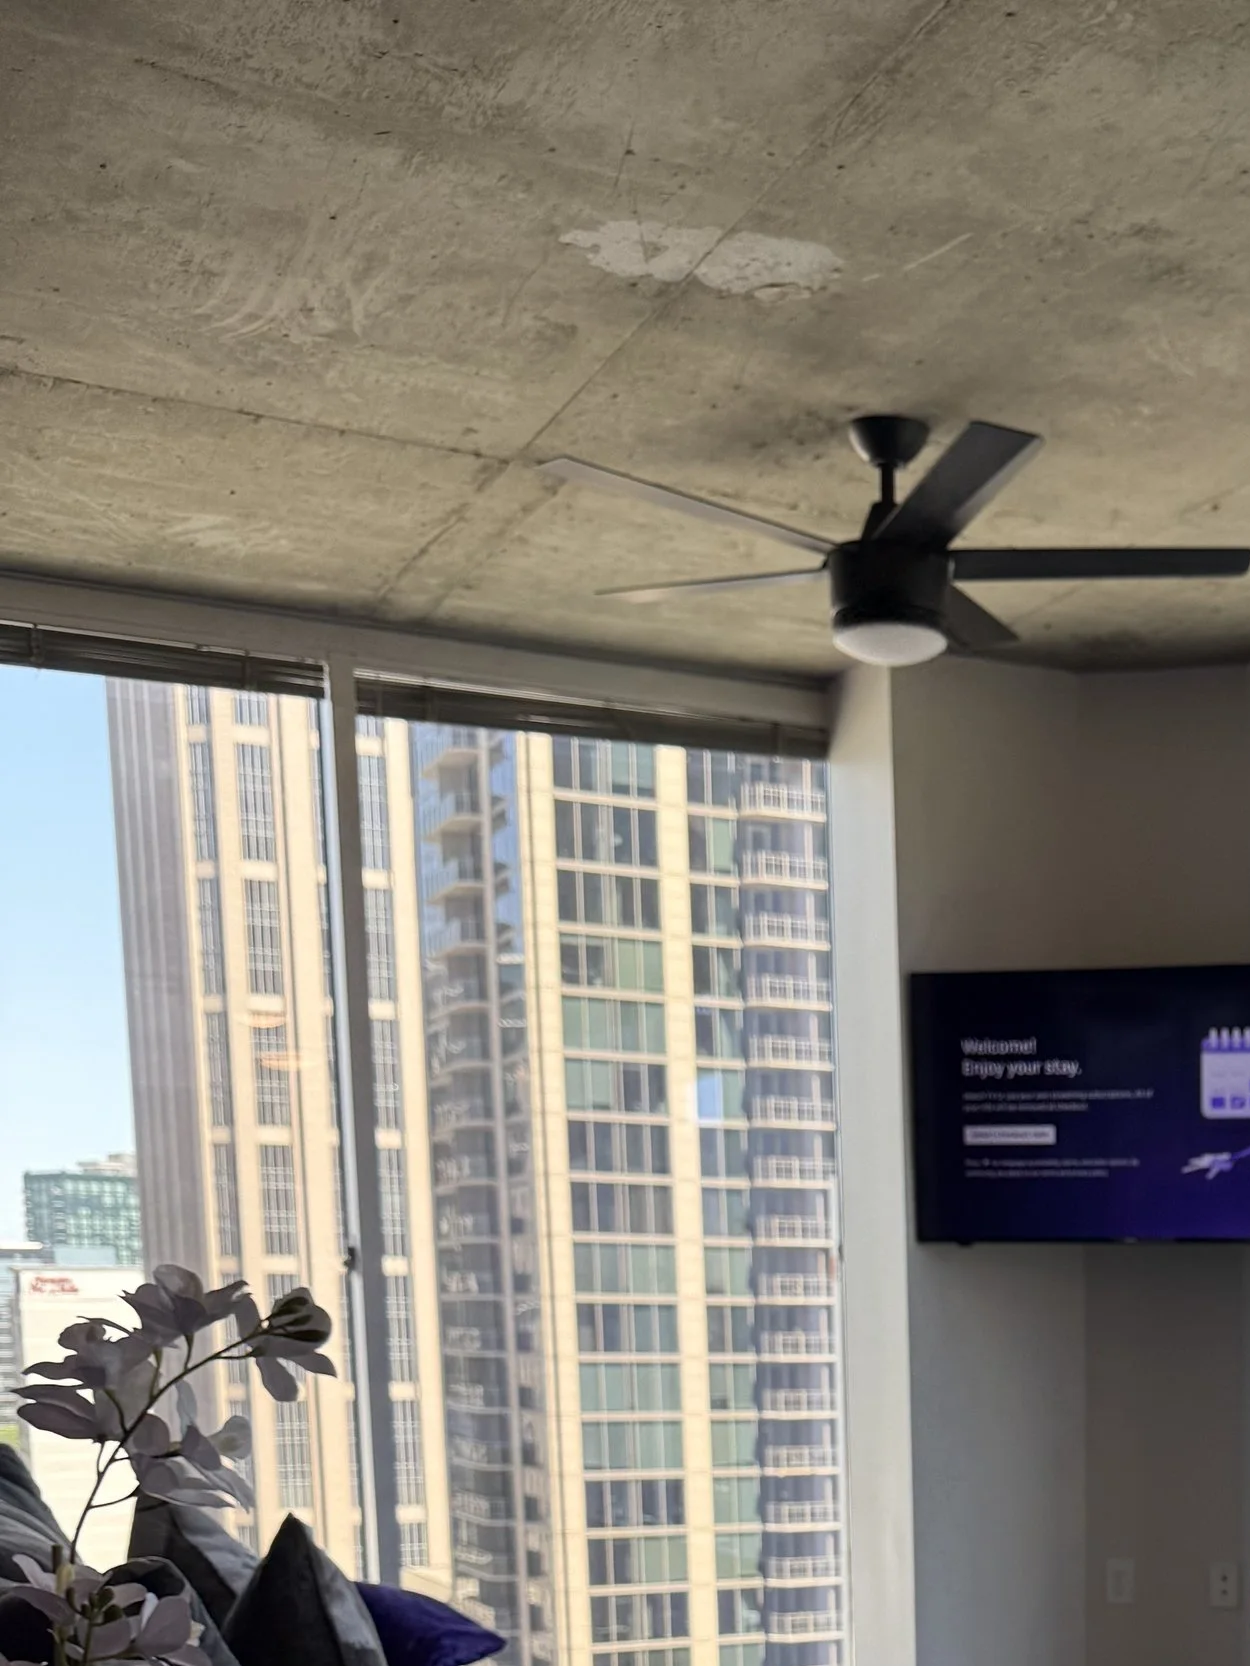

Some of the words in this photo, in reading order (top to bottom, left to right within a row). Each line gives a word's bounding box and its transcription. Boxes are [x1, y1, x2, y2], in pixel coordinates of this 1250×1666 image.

[961, 1036, 1037, 1055] Welcome!
[961, 1058, 1004, 1080] Enjoy
[1006, 1060, 1041, 1080] your
